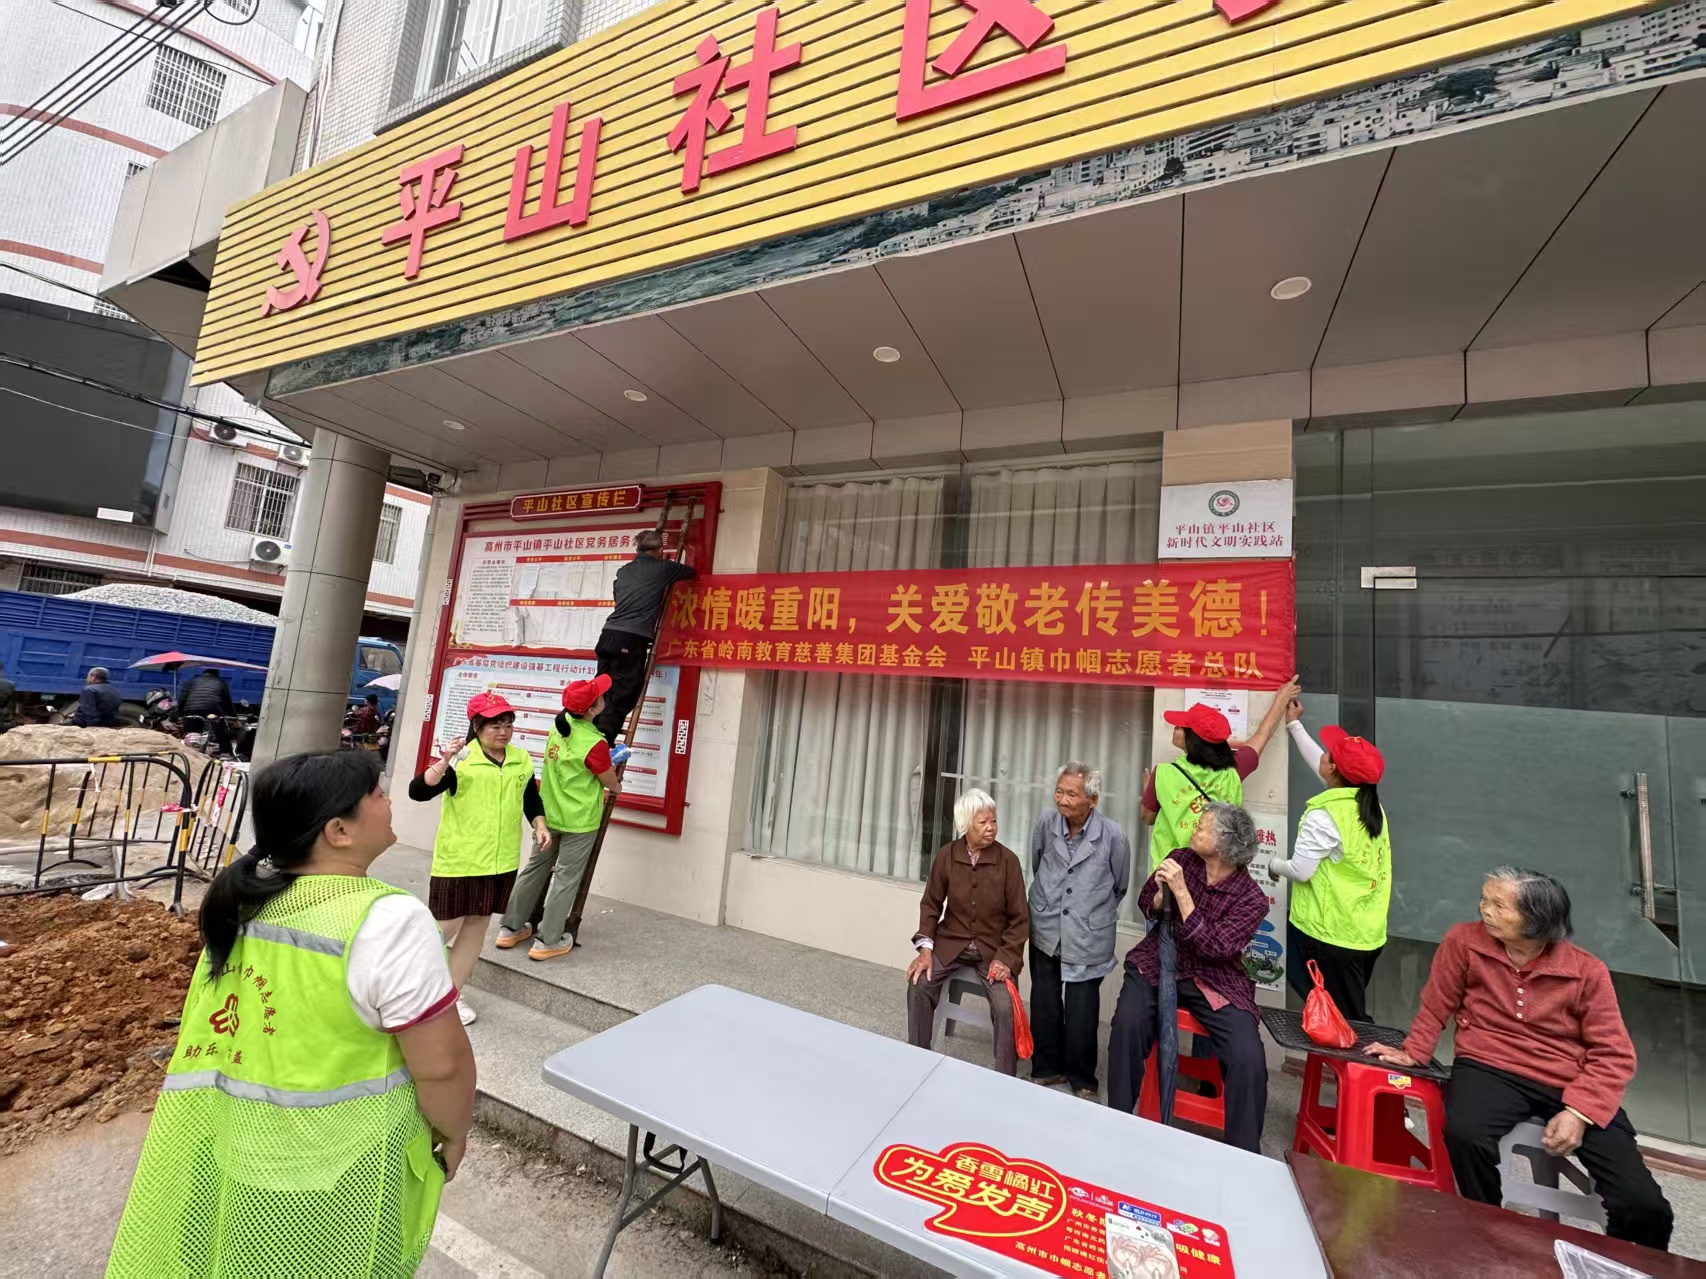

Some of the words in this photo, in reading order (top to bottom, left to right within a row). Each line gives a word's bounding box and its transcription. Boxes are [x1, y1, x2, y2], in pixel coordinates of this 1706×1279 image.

[381, 0, 1276, 279] 平山社区
[522, 489, 627, 513] 平山社区宣传栏
[1166, 534, 1284, 549] 新时代文明实践站
[1175, 520, 1276, 535] 平山镇平山社区
[665, 638, 948, 669] 广东省岭南教育慈善集团基金会
[968, 645, 1264, 680] 平山镇巾帼志愿者总队
[891, 1156, 1054, 1222] 为爱发声
[955, 1153, 1056, 1202] 香雪橘红
